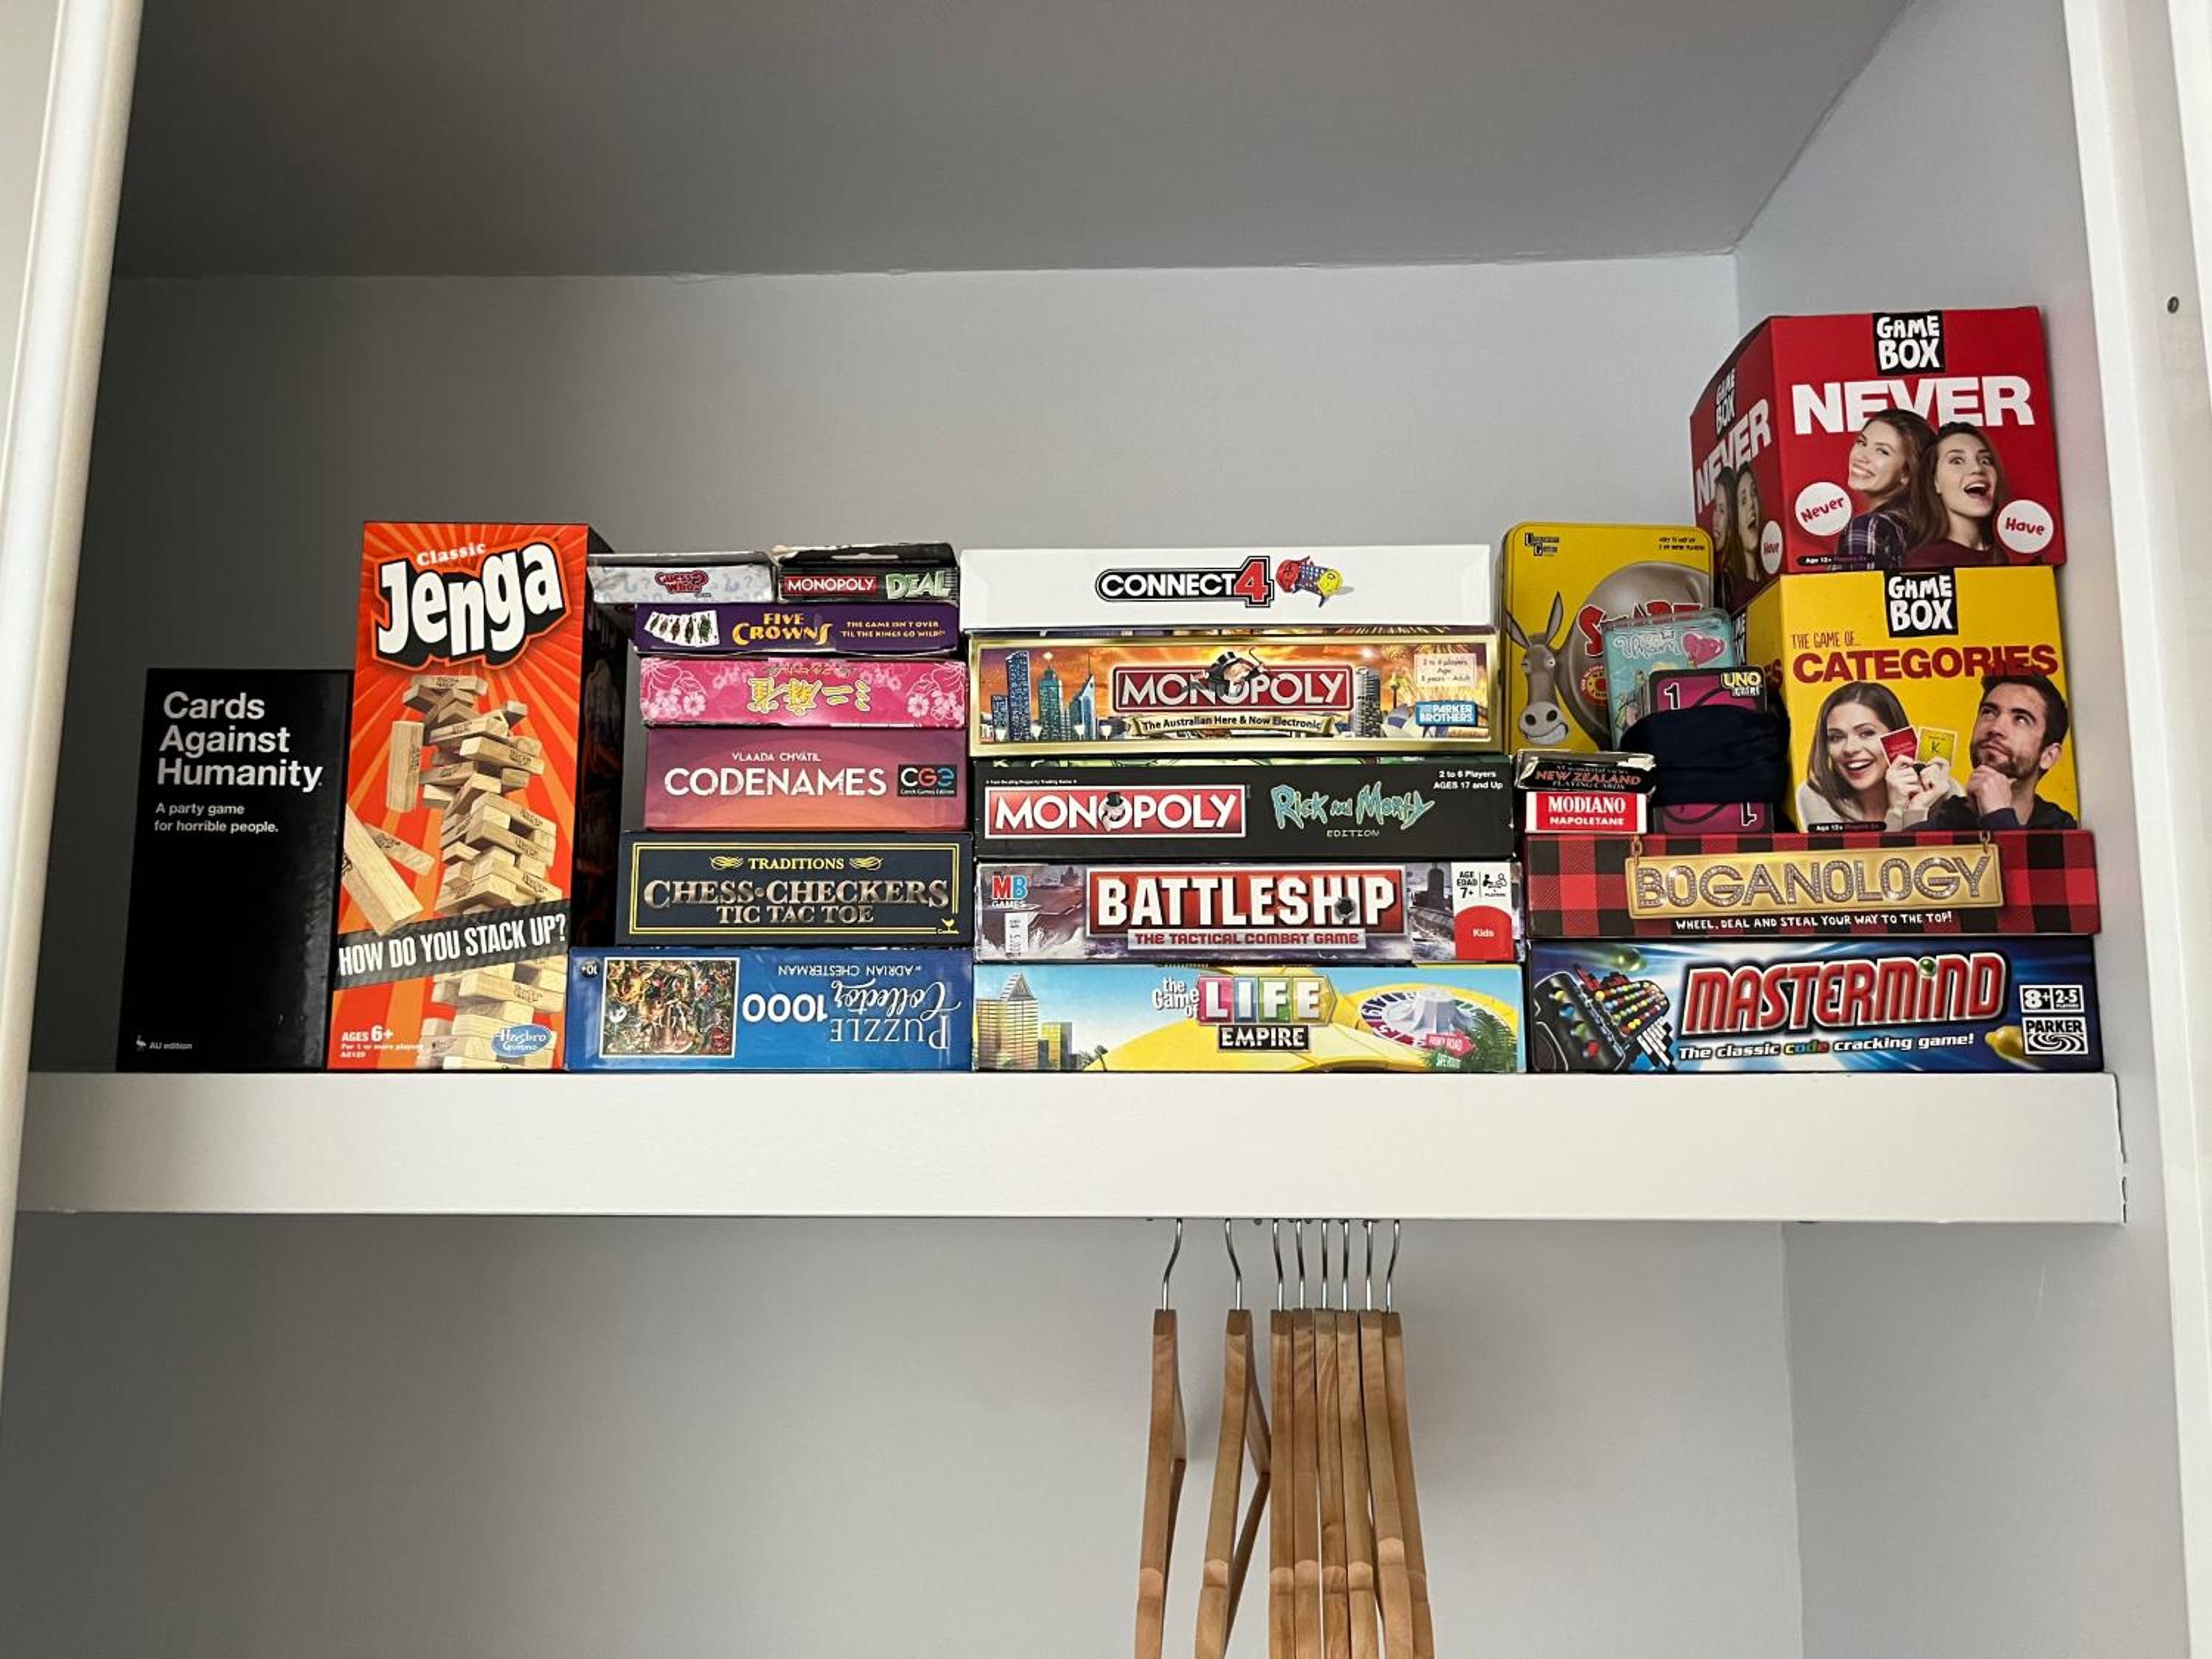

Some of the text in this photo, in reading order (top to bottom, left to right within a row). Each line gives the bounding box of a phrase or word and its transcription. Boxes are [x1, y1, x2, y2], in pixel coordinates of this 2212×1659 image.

[1877, 315, 1941, 339] GAME
[1878, 338, 1940, 370] BOX
[1792, 375, 2036, 435] NEVER
[1696, 398, 1772, 514] NEVER
[1800, 496, 1845, 523] Never
[2005, 518, 2045, 536] Have
[417, 542, 487, 567] Classic
[787, 571, 952, 599] MONOPOLY DEAL
[1100, 559, 1269, 603] CONNECT 4
[1888, 575, 1952, 599] GAME
[378, 543, 564, 656] Jenga
[762, 613, 804, 625] FIVE
[1889, 599, 1953, 632] BOX
[732, 623, 833, 645] CROWNS
[1792, 633, 1812, 650] THE
[1813, 632, 1840, 648] GAME
[1792, 644, 2059, 684] CATEGORIES
[1723, 672, 1761, 687] UNO
[162, 691, 265, 720] Cards
[748, 676, 871, 716] ミニ麻雀
[1663, 682, 1680, 709] 1
[1419, 713, 1473, 723] BROTHERS
[1433, 703, 1473, 713] PARKER
[1143, 715, 1322, 731] The Australian Here & Now Electronic
[159, 725, 291, 758] Against
[731, 752, 775, 762] VLAADA
[664, 767, 887, 797] CODENAMES
[1464, 771, 1497, 779] Players
[1535, 771, 1641, 785] NEW ZEALAND
[1433, 782, 1503, 790] AGES 17 and Up
[156, 803, 245, 816] A party game
[995, 793, 1237, 830] MONOPOLY
[1271, 785, 1328, 830] Rick
[1356, 781, 1435, 830] Morty
[1548, 796, 1626, 813] MODIANO
[154, 820, 279, 835] for horrible people.
[1549, 817, 1624, 827] NAPOLETANE
[1326, 830, 1380, 838] EDITION
[748, 857, 845, 870] TRADITIONS
[992, 874, 1029, 900] MB
[1456, 878, 1478, 886] EDAD
[1635, 855, 1991, 909] BOGANOLOGY
[1096, 874, 1396, 926] BATTLESHIP
[1459, 887, 1473, 898] 7+
[717, 905, 874, 925] TIC TAC TOE
[1675, 911, 1952, 931] WHEEL, DEAL AND STEAL YOUR WAY TO THE TOP!
[1135, 933, 1360, 945] THE TACTICAL COMBAT GAME
[1472, 928, 1495, 937] Kids
[338, 913, 567, 976] HOW DO YOU STACK UP?
[581, 965, 598, 975] 10+
[779, 964, 860, 976] CHESTERMAN
[866, 965, 913, 976] ADRIAN
[1162, 977, 1185, 994] the
[1681, 953, 2006, 1035] MASTERMIND
[831, 980, 961, 1022] Collector
[1152, 988, 1200, 1009] Game
[1206, 981, 1320, 1019] LIFE
[2024, 989, 2079, 1009] 8+ 2-5
[1186, 1003, 1198, 1018] of
[742, 992, 950, 1050] PUZZLE 1000
[2025, 1020, 2084, 1033] PARKER
[341, 1025, 394, 1043] AGES 6+
[495, 1028, 547, 1046] Hasbro
[1222, 1027, 1305, 1047] EMPIRE
[149, 1041, 192, 1050] AU edition
[1679, 1033, 1974, 1060] The classic code cracking game!
